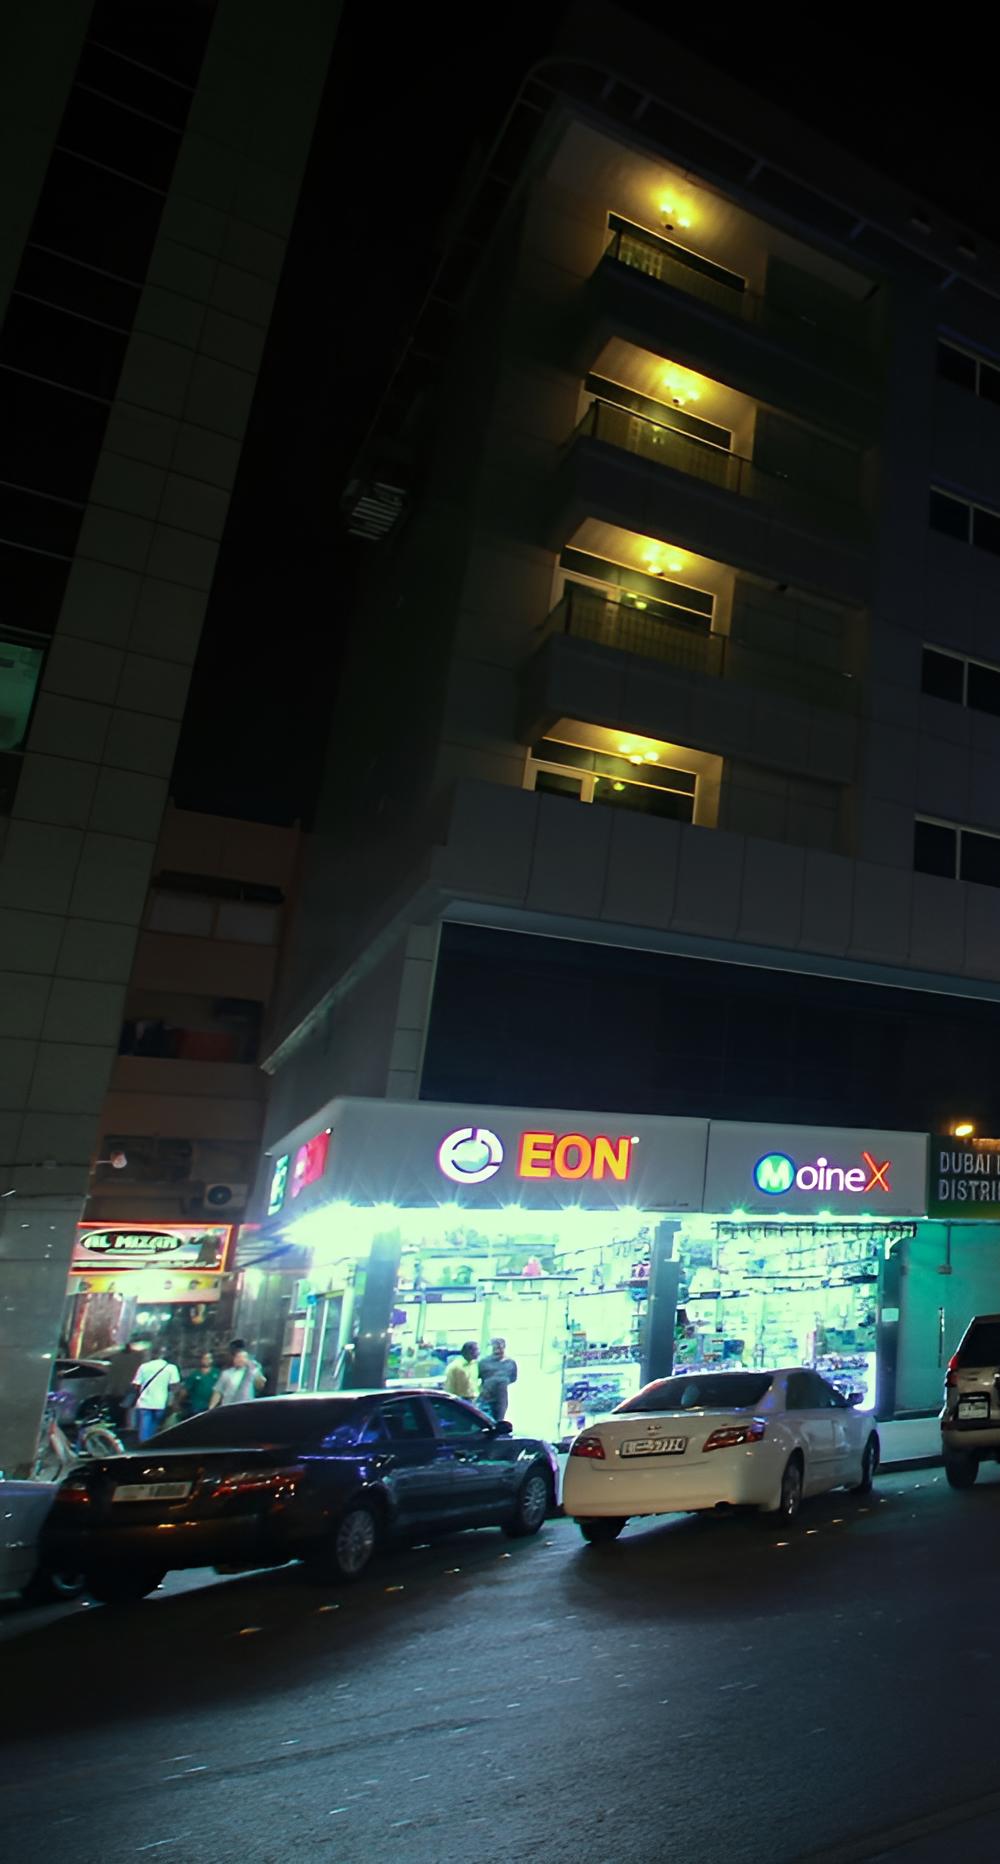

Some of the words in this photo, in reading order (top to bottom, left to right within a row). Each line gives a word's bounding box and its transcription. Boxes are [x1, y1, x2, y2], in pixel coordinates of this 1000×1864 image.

[518, 1131, 631, 1181] EON
[754, 1151, 891, 1195] MoineX
[939, 1151, 991, 1174] DUBAI
